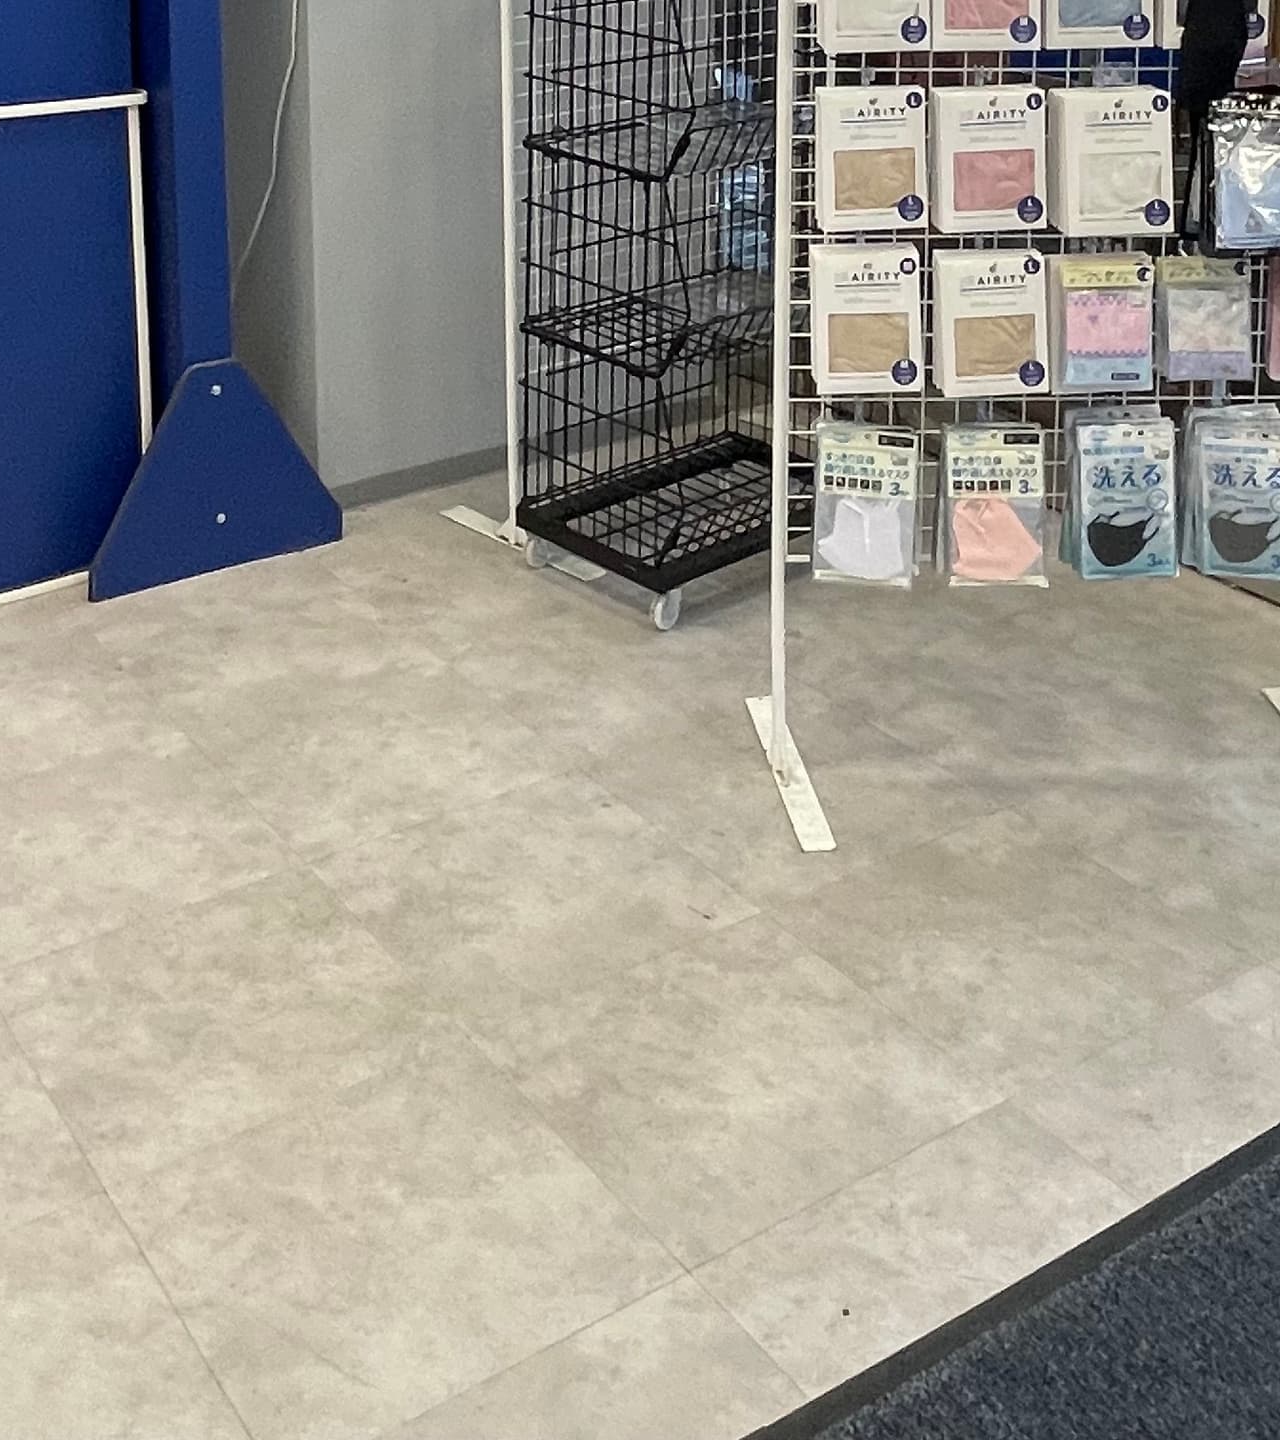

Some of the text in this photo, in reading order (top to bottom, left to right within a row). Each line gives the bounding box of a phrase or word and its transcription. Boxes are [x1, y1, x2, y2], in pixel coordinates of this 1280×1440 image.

[858, 107, 907, 117] AIRITY
[977, 110, 1026, 119] AIRITY
[1103, 111, 1152, 120] AIRITY
[852, 272, 901, 281] AIRITY
[977, 275, 1026, 285] AIRITY
[1091, 462, 1162, 490] 洗える
